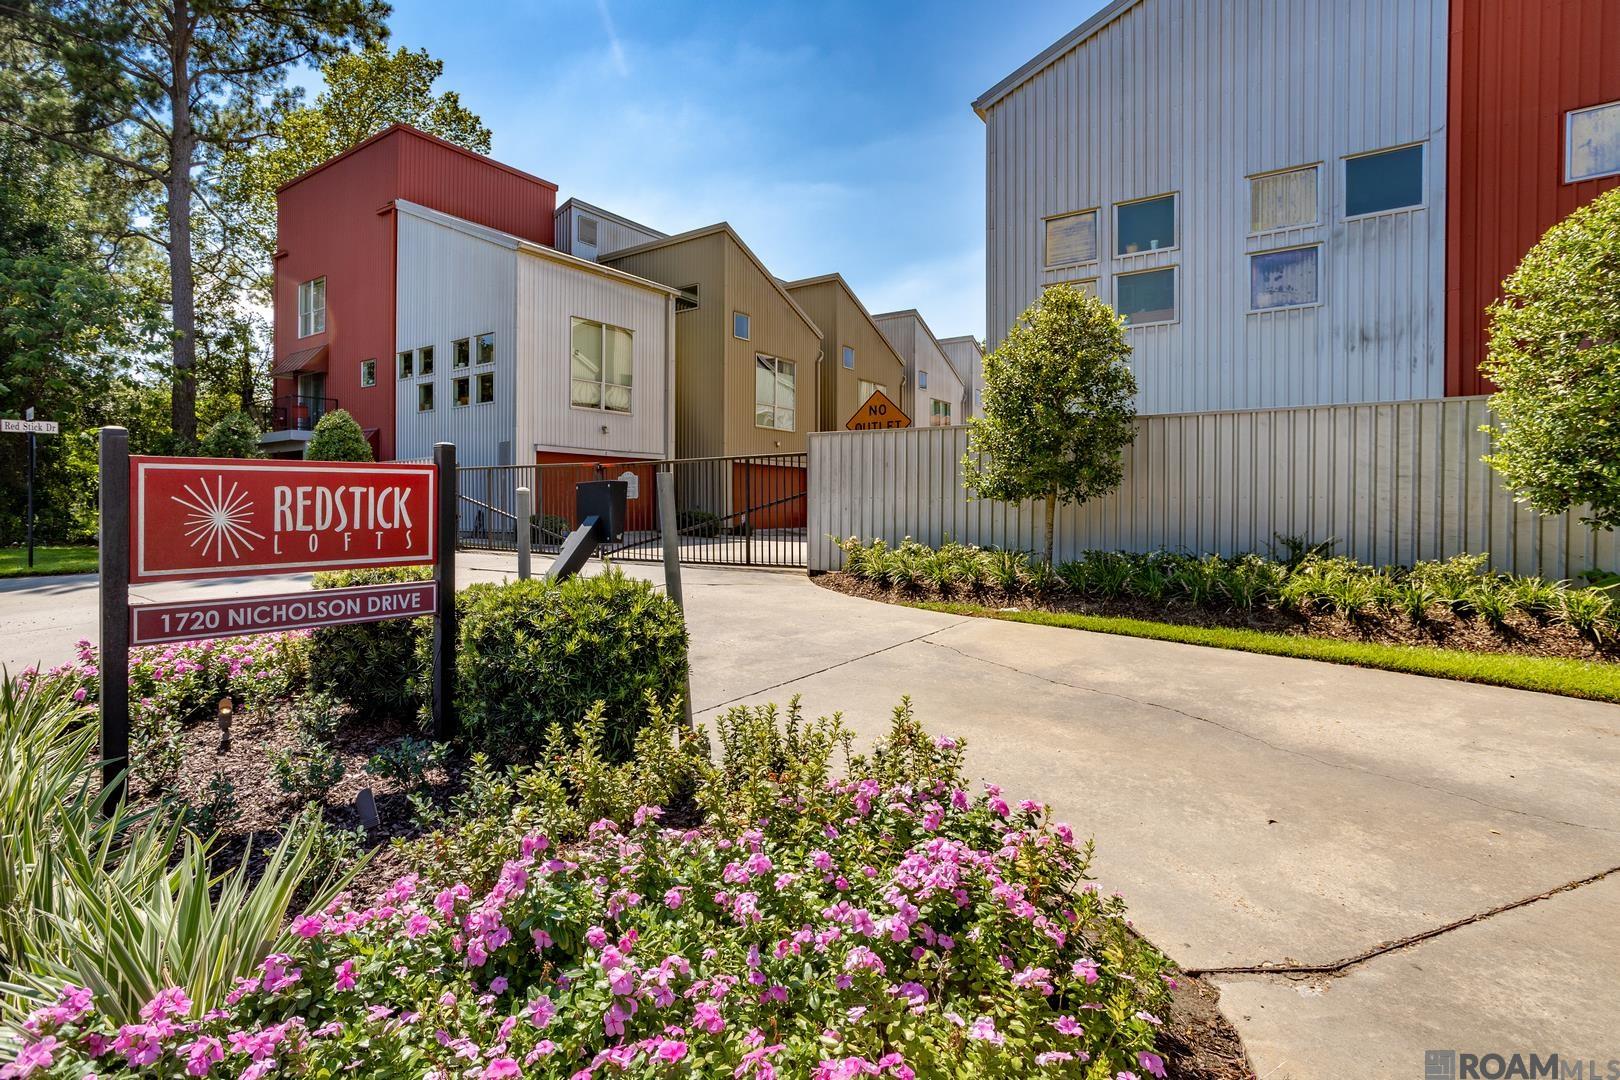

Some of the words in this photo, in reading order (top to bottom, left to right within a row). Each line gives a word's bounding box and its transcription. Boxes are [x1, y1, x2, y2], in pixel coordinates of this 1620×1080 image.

[869, 404, 887, 416] NO
[4, 421, 20, 431] Red
[22, 422, 43, 432] Stick
[46, 423, 56, 432] Dr
[855, 420, 902, 430] OUTLET
[273, 485, 413, 532] REDSTICK
[273, 529, 412, 555] LOFTS
[161, 610, 220, 633] 1720
[228, 598, 361, 627] NICHOLSON
[367, 592, 421, 613] DRIVE
